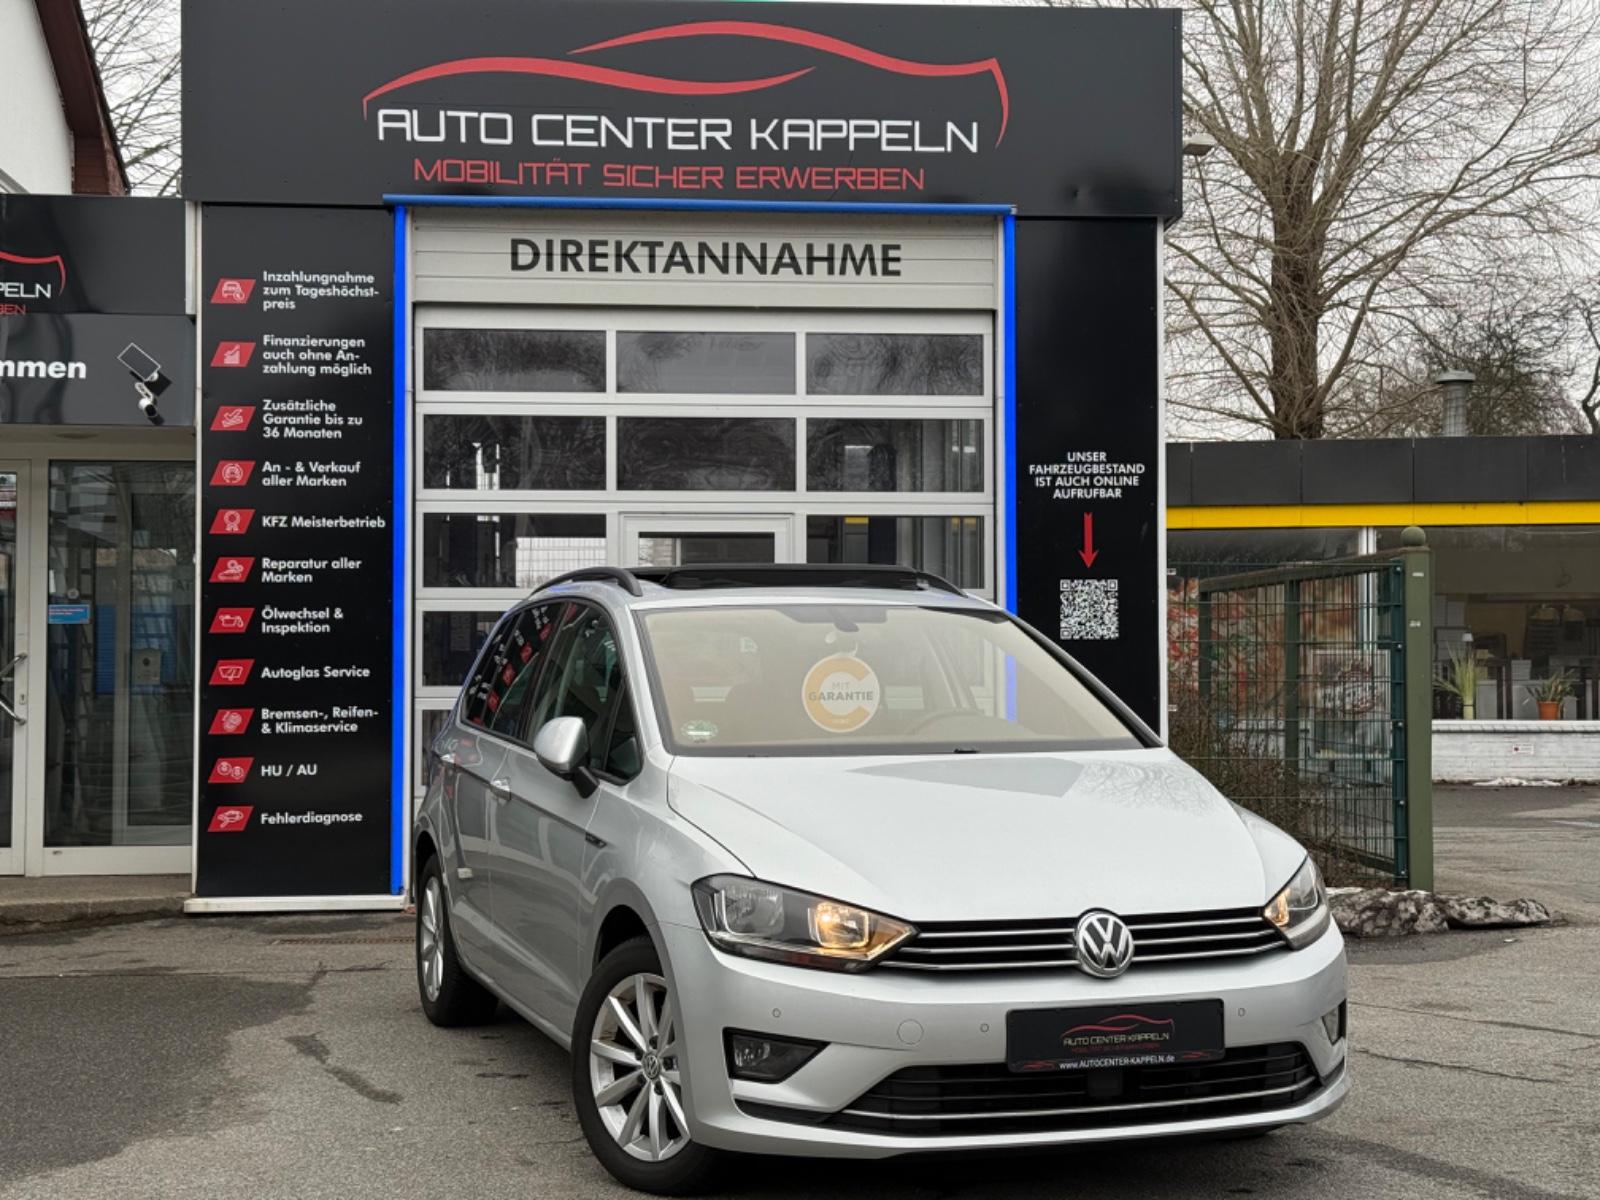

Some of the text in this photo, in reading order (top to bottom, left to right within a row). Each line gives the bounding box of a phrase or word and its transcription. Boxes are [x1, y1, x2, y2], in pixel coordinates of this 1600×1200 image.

[378, 109, 977, 152] AUTO CENTER KAPPELN
[413, 157, 925, 191] MOBILITÄT SICHER ERWERBEN
[510, 239, 902, 277] DIREKTANNAHME
[264, 271, 374, 285] Inzahlungnahme
[263, 285, 379, 299] zum Tageshöchst-
[263, 299, 296, 312] preis
[263, 335, 365, 350] Finanzierungen
[263, 349, 360, 360] auch ohne An-
[263, 362, 371, 377] zahlung möglich
[263, 399, 335, 411] Zusätzliche
[263, 413, 362, 425] Garantie bis zu
[263, 427, 341, 438] 36 Monaten
[1068, 452, 1106, 462] UNSER
[262, 461, 281, 472] An
[295, 462, 304, 472] &
[309, 461, 360, 473] Verkauf
[1030, 464, 1145, 474] FAHRZEUGBESTAND
[262, 475, 346, 486] aller Marken
[1036, 476, 1138, 486] IST AUCH ONLINE
[1053, 488, 1121, 498] AUFRUFBAR
[263, 516, 385, 527] KFZ Meisterbetrieb
[262, 557, 361, 570] Reparatur aller
[262, 571, 312, 582] Marken
[262, 606, 343, 619] Ölwechsel &
[262, 621, 330, 635] Inspektion
[261, 666, 370, 680] Autoglas Service
[808, 691, 873, 701] GARANTIE
[262, 706, 378, 719] Bremsen-, Reifen-
[261, 721, 358, 733] & Klimaservice
[262, 765, 282, 776] HU
[297, 764, 317, 775] AU
[261, 812, 362, 825] Fehlerdiagnose
[1064, 1033, 1169, 1045] AUTO CENTER KAPPELN
